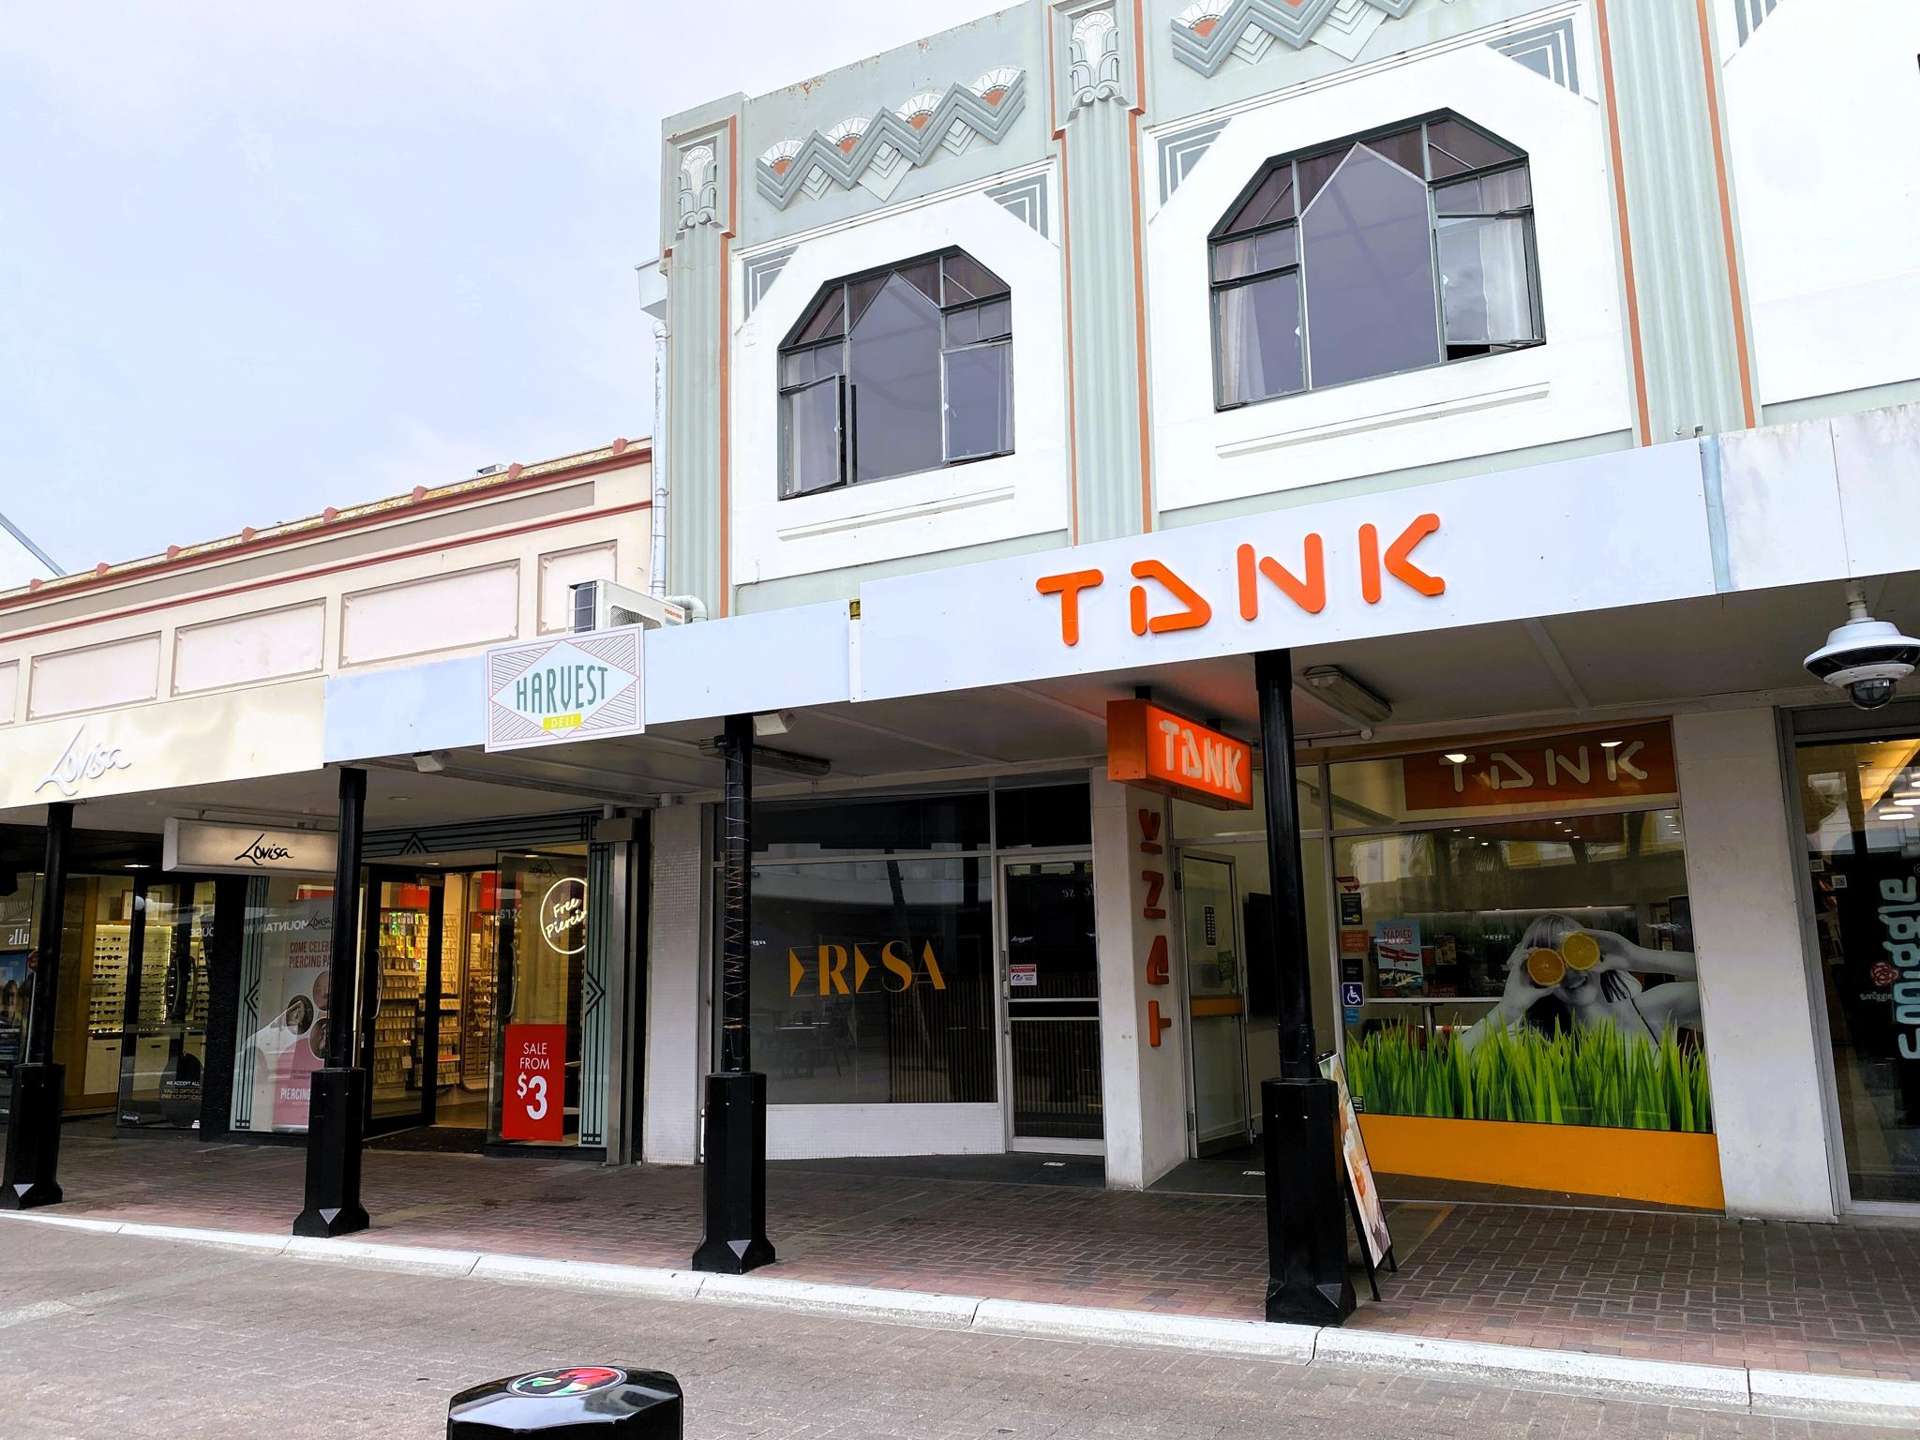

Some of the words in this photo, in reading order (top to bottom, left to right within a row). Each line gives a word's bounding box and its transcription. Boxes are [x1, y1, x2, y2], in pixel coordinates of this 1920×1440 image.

[1036, 513, 1446, 646] TANK
[516, 665, 608, 714] HARVEST
[34, 721, 132, 797] Lovisa
[1159, 719, 1242, 793] TANK
[1439, 740, 1648, 792] TANK
[234, 833, 295, 866] Lovisa
[553, 898, 580, 918] Free
[289, 955, 322, 969] PIERCING
[789, 940, 946, 998] ERESA
[520, 1058, 550, 1070] FROM
[523, 1042, 548, 1055] SALE
[517, 1072, 547, 1120] $3
